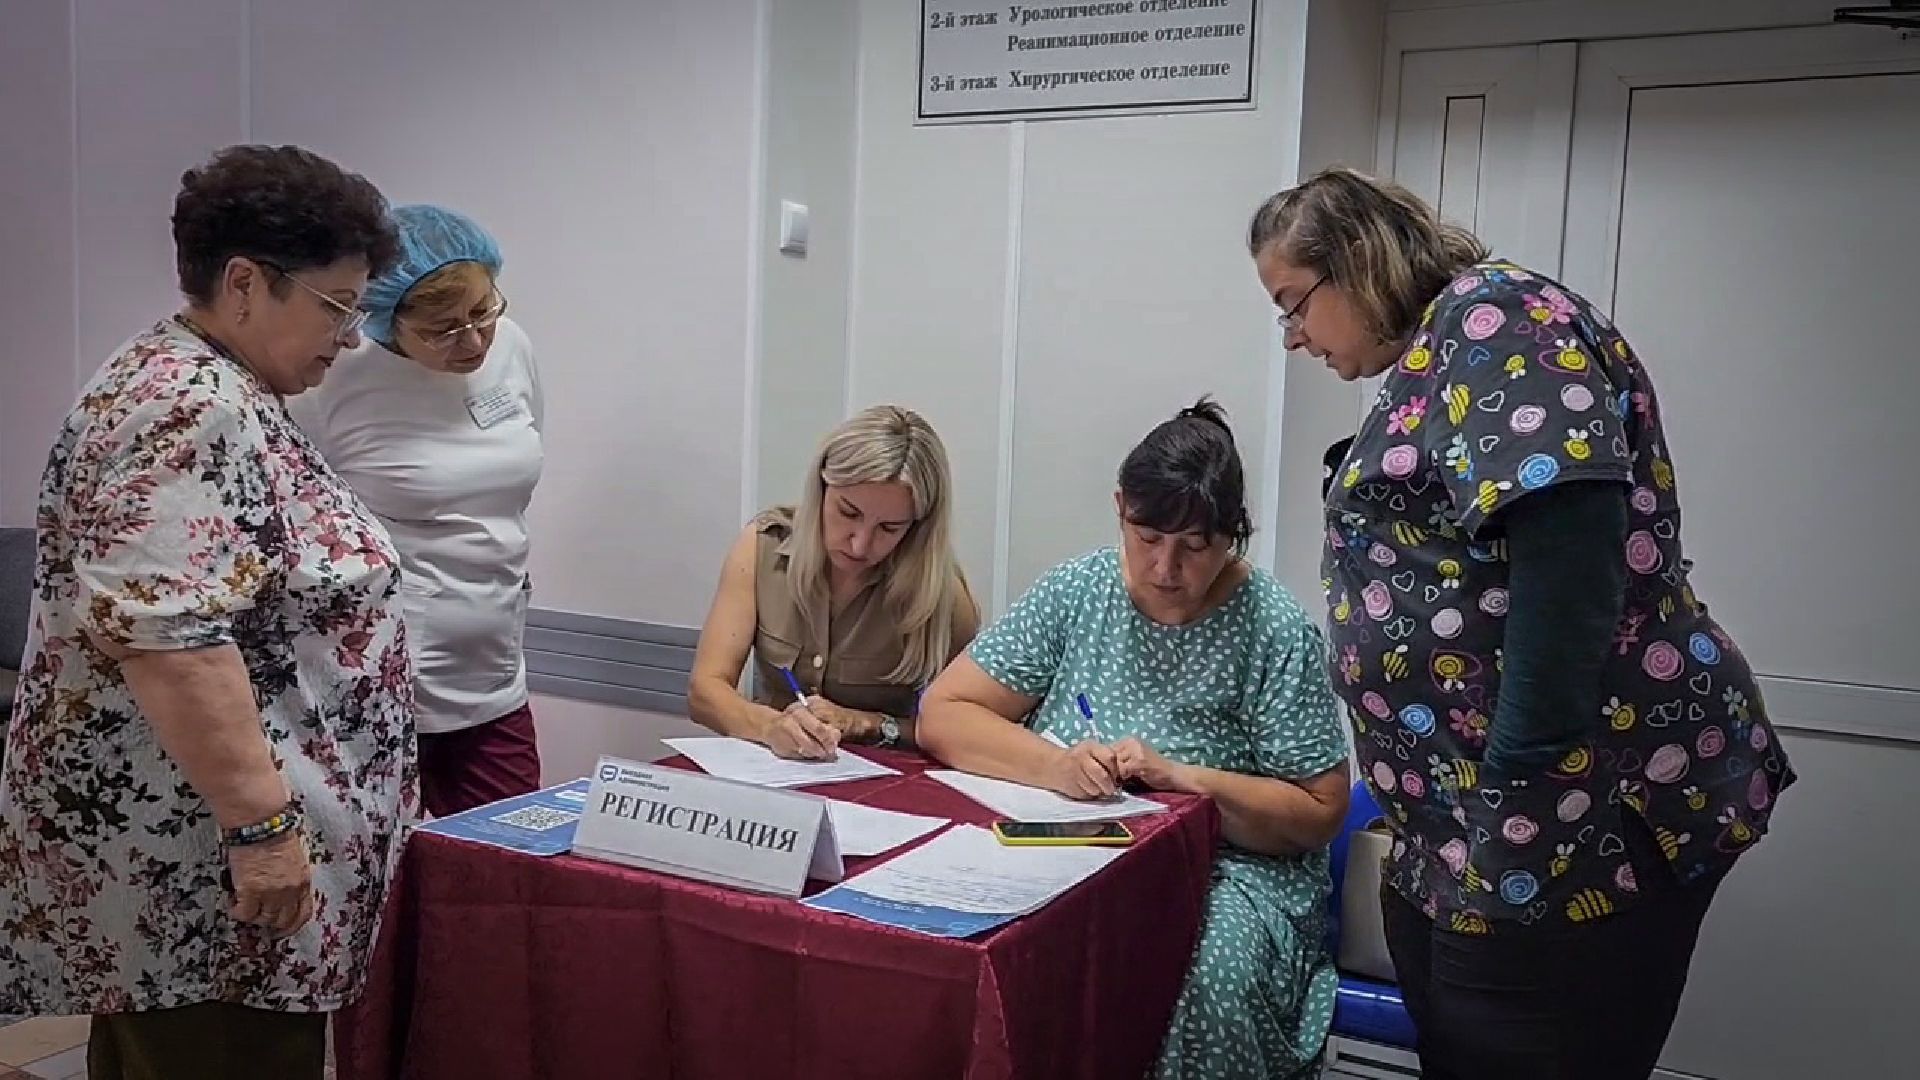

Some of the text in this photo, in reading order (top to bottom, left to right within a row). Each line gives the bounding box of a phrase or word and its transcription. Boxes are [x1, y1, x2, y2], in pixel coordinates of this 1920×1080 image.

[930, 12, 954, 28] 2-й
[960, 12, 997, 27] этаж
[1008, 3, 1132, 25] Урологическое
[1008, 23, 1245, 51] Реанимационное отделение
[930, 63, 1230, 91] 3-й этаж Хирургическое отделение
[601, 793, 798, 852] РЕГИСТРАЦИЯ
